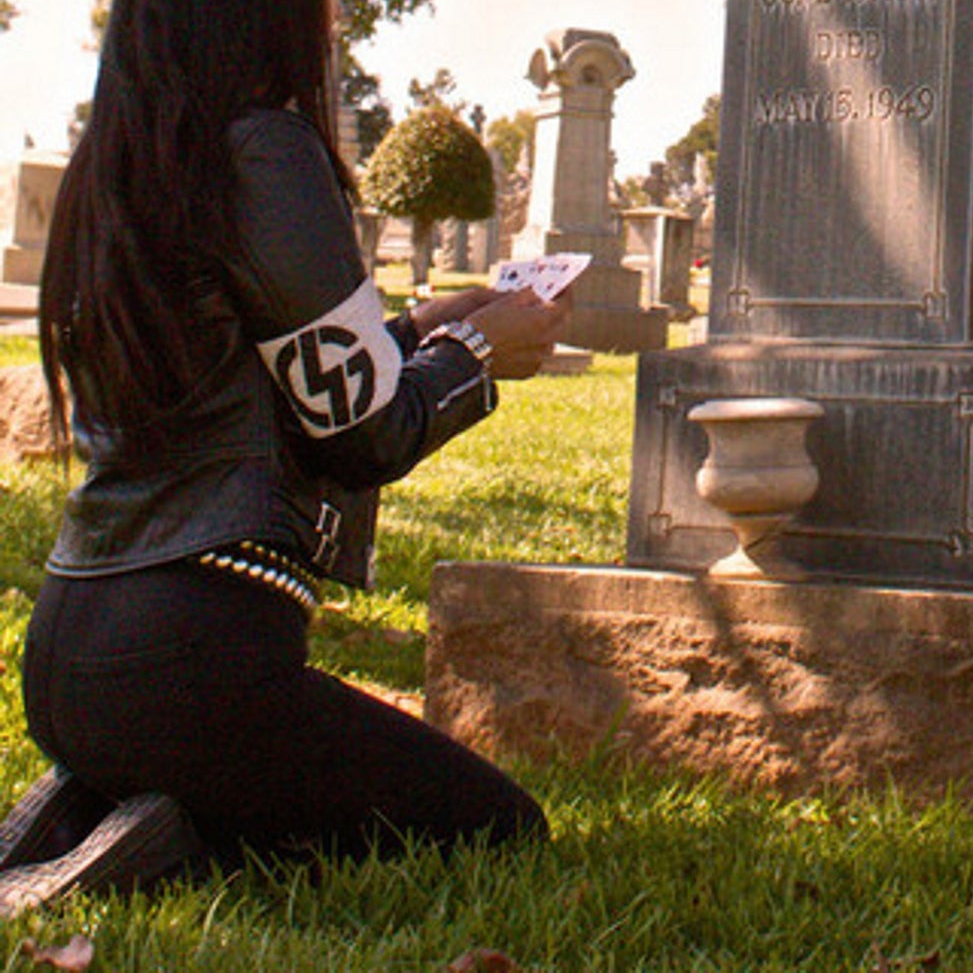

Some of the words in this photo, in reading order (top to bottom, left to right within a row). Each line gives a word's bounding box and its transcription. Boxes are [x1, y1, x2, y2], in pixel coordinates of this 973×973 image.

[817, 30, 882, 61] DIED
[755, 89, 819, 123] MAY
[867, 85, 936, 123] 1949
